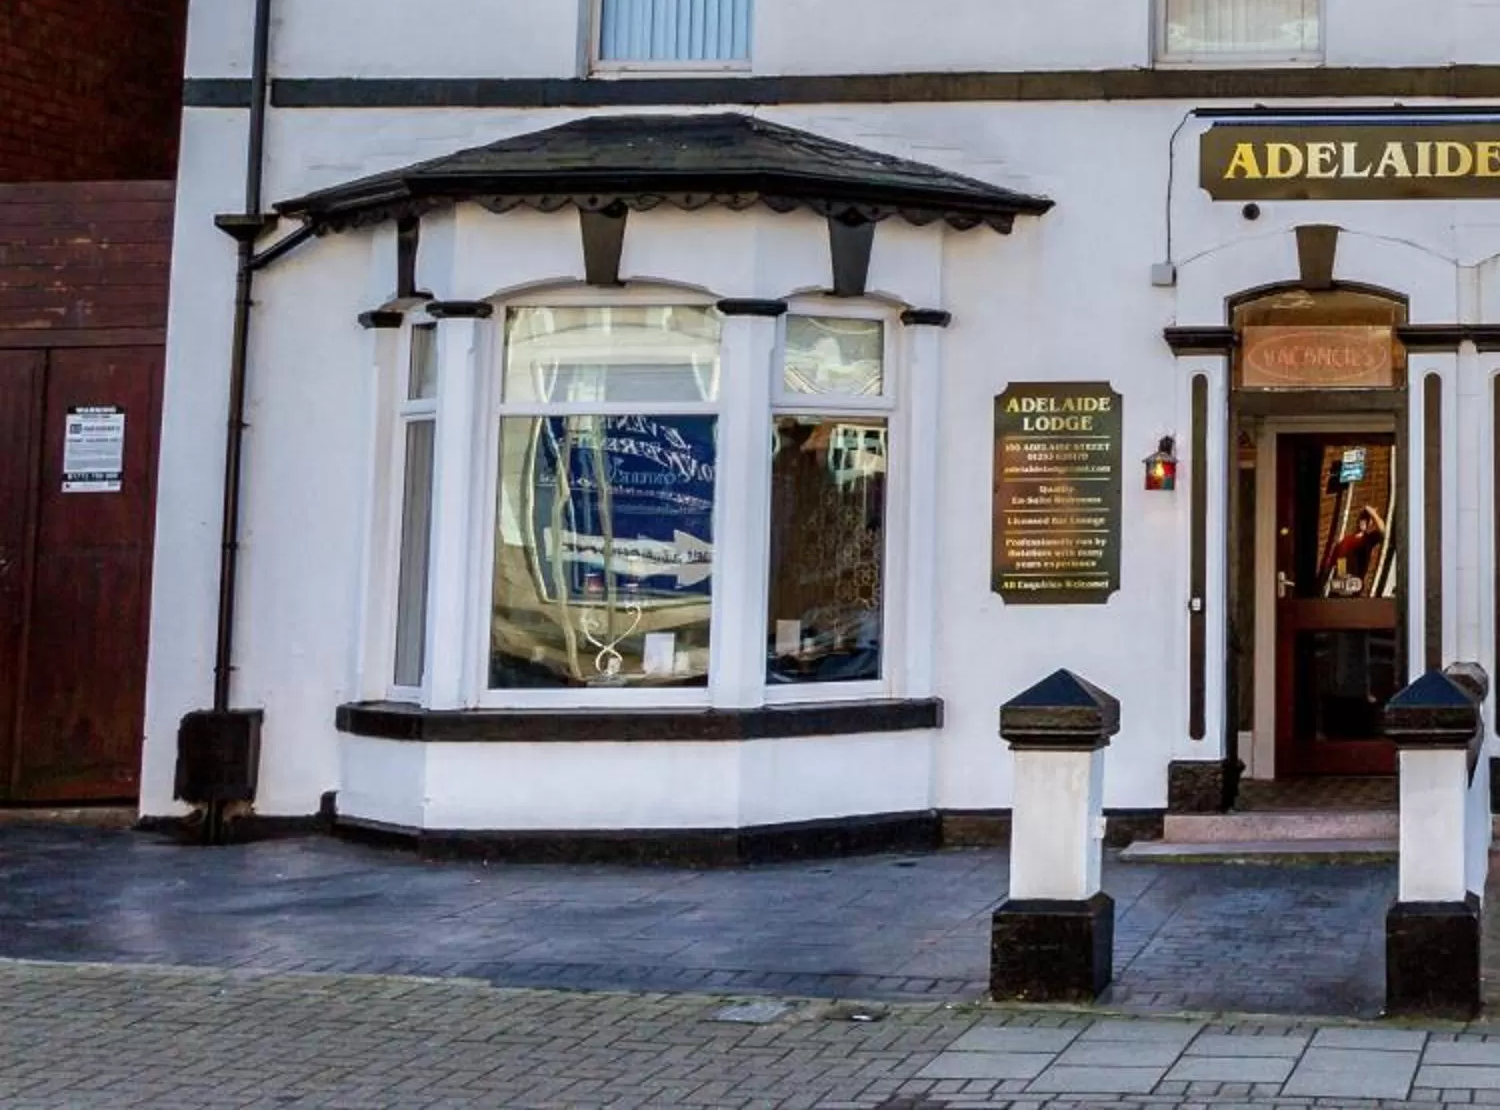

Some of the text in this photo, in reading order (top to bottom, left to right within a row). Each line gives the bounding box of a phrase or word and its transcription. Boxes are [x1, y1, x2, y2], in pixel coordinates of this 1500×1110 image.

[1263, 345, 1375, 368] VACANCIES
[1006, 397, 1111, 413] ADELAIDE
[1023, 416, 1093, 431] LODGE
[1074, 442, 1111, 451] STREET
[1007, 517, 1050, 526] Licensed
[1069, 517, 1105, 526] Lounge
[1005, 538, 1073, 548] Professionally
[1094, 538, 1107, 547] by
[1015, 561, 1097, 570] years experience
[1002, 581, 1016, 589] All
[1017, 581, 1063, 591] Enquiries
